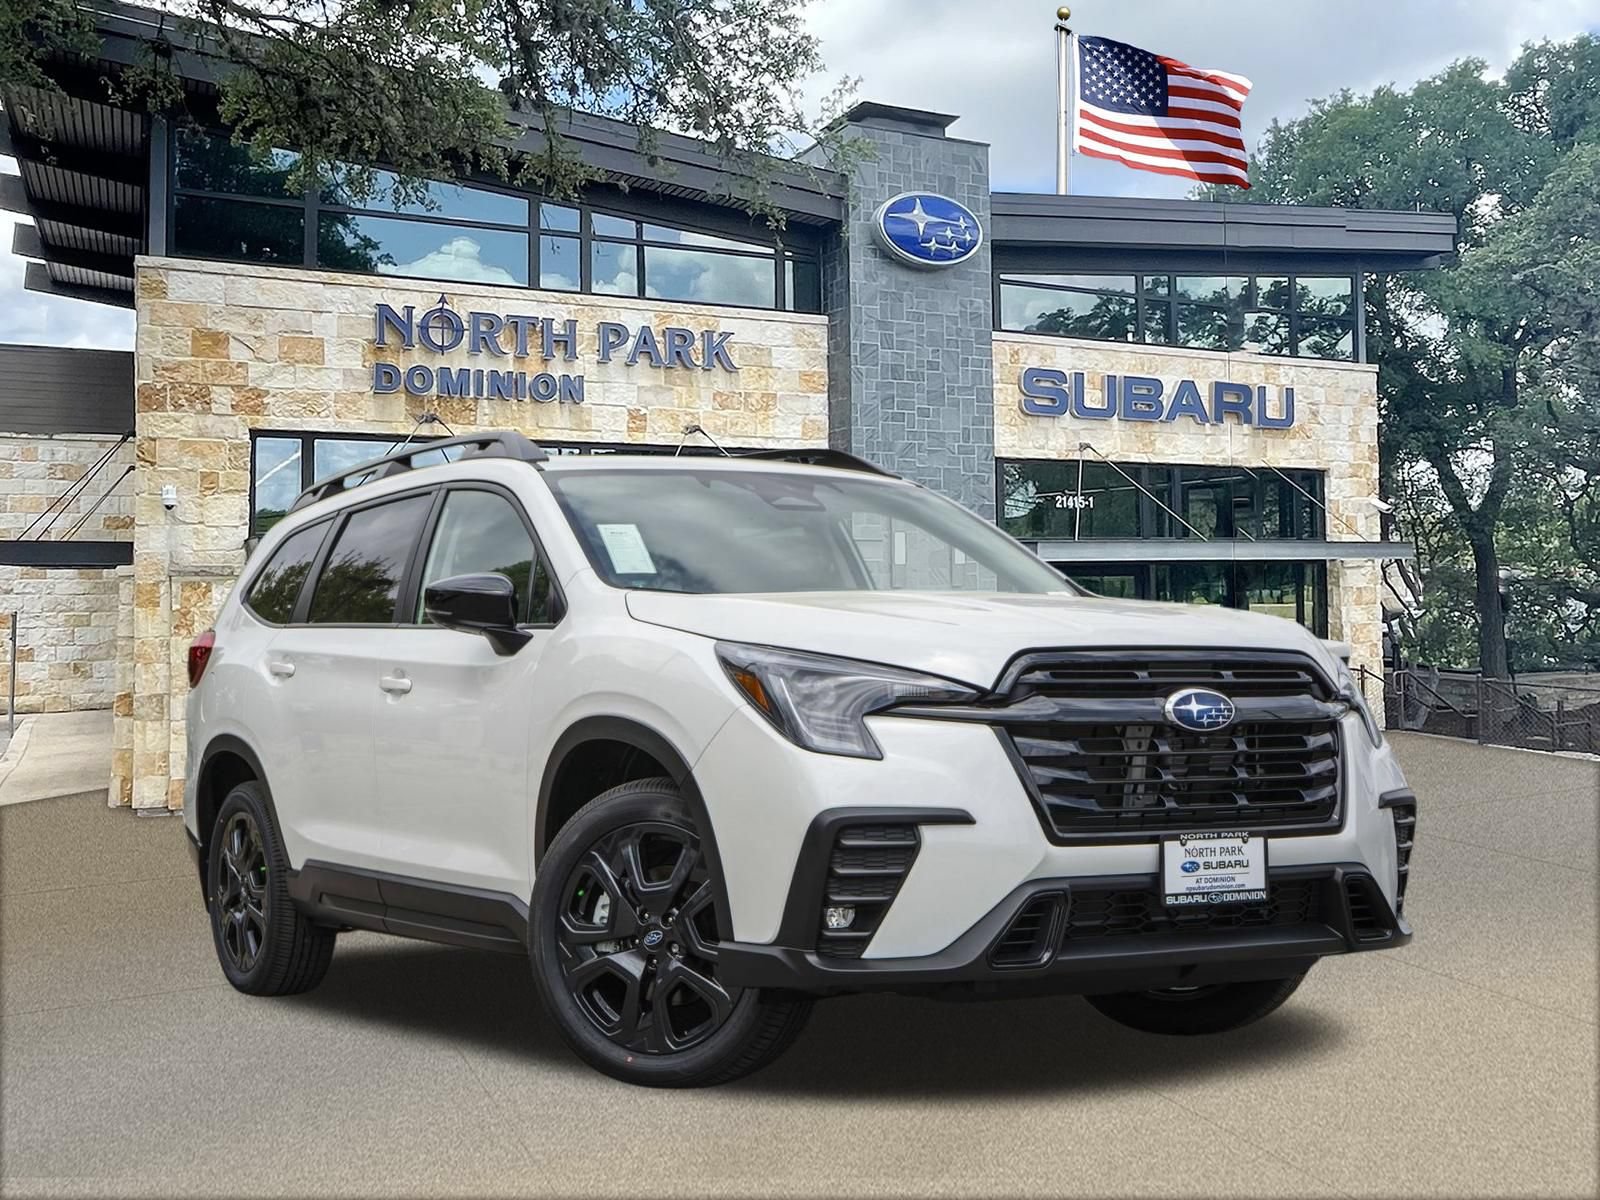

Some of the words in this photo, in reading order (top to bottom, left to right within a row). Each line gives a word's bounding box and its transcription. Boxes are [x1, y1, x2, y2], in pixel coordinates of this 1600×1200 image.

[375, 293, 579, 361] NORTH
[596, 322, 741, 373] PARK
[373, 362, 584, 404] DOMINION
[1019, 366, 1295, 429] SUBARU
[1180, 832, 1217, 840] NORTH
[1184, 846, 1216, 858] NORTH
[1219, 846, 1245, 857] PARK
[1203, 860, 1249, 870] SUBARU
[1166, 894, 1207, 904] SUBARU
[1223, 891, 1266, 902] DOMINION
